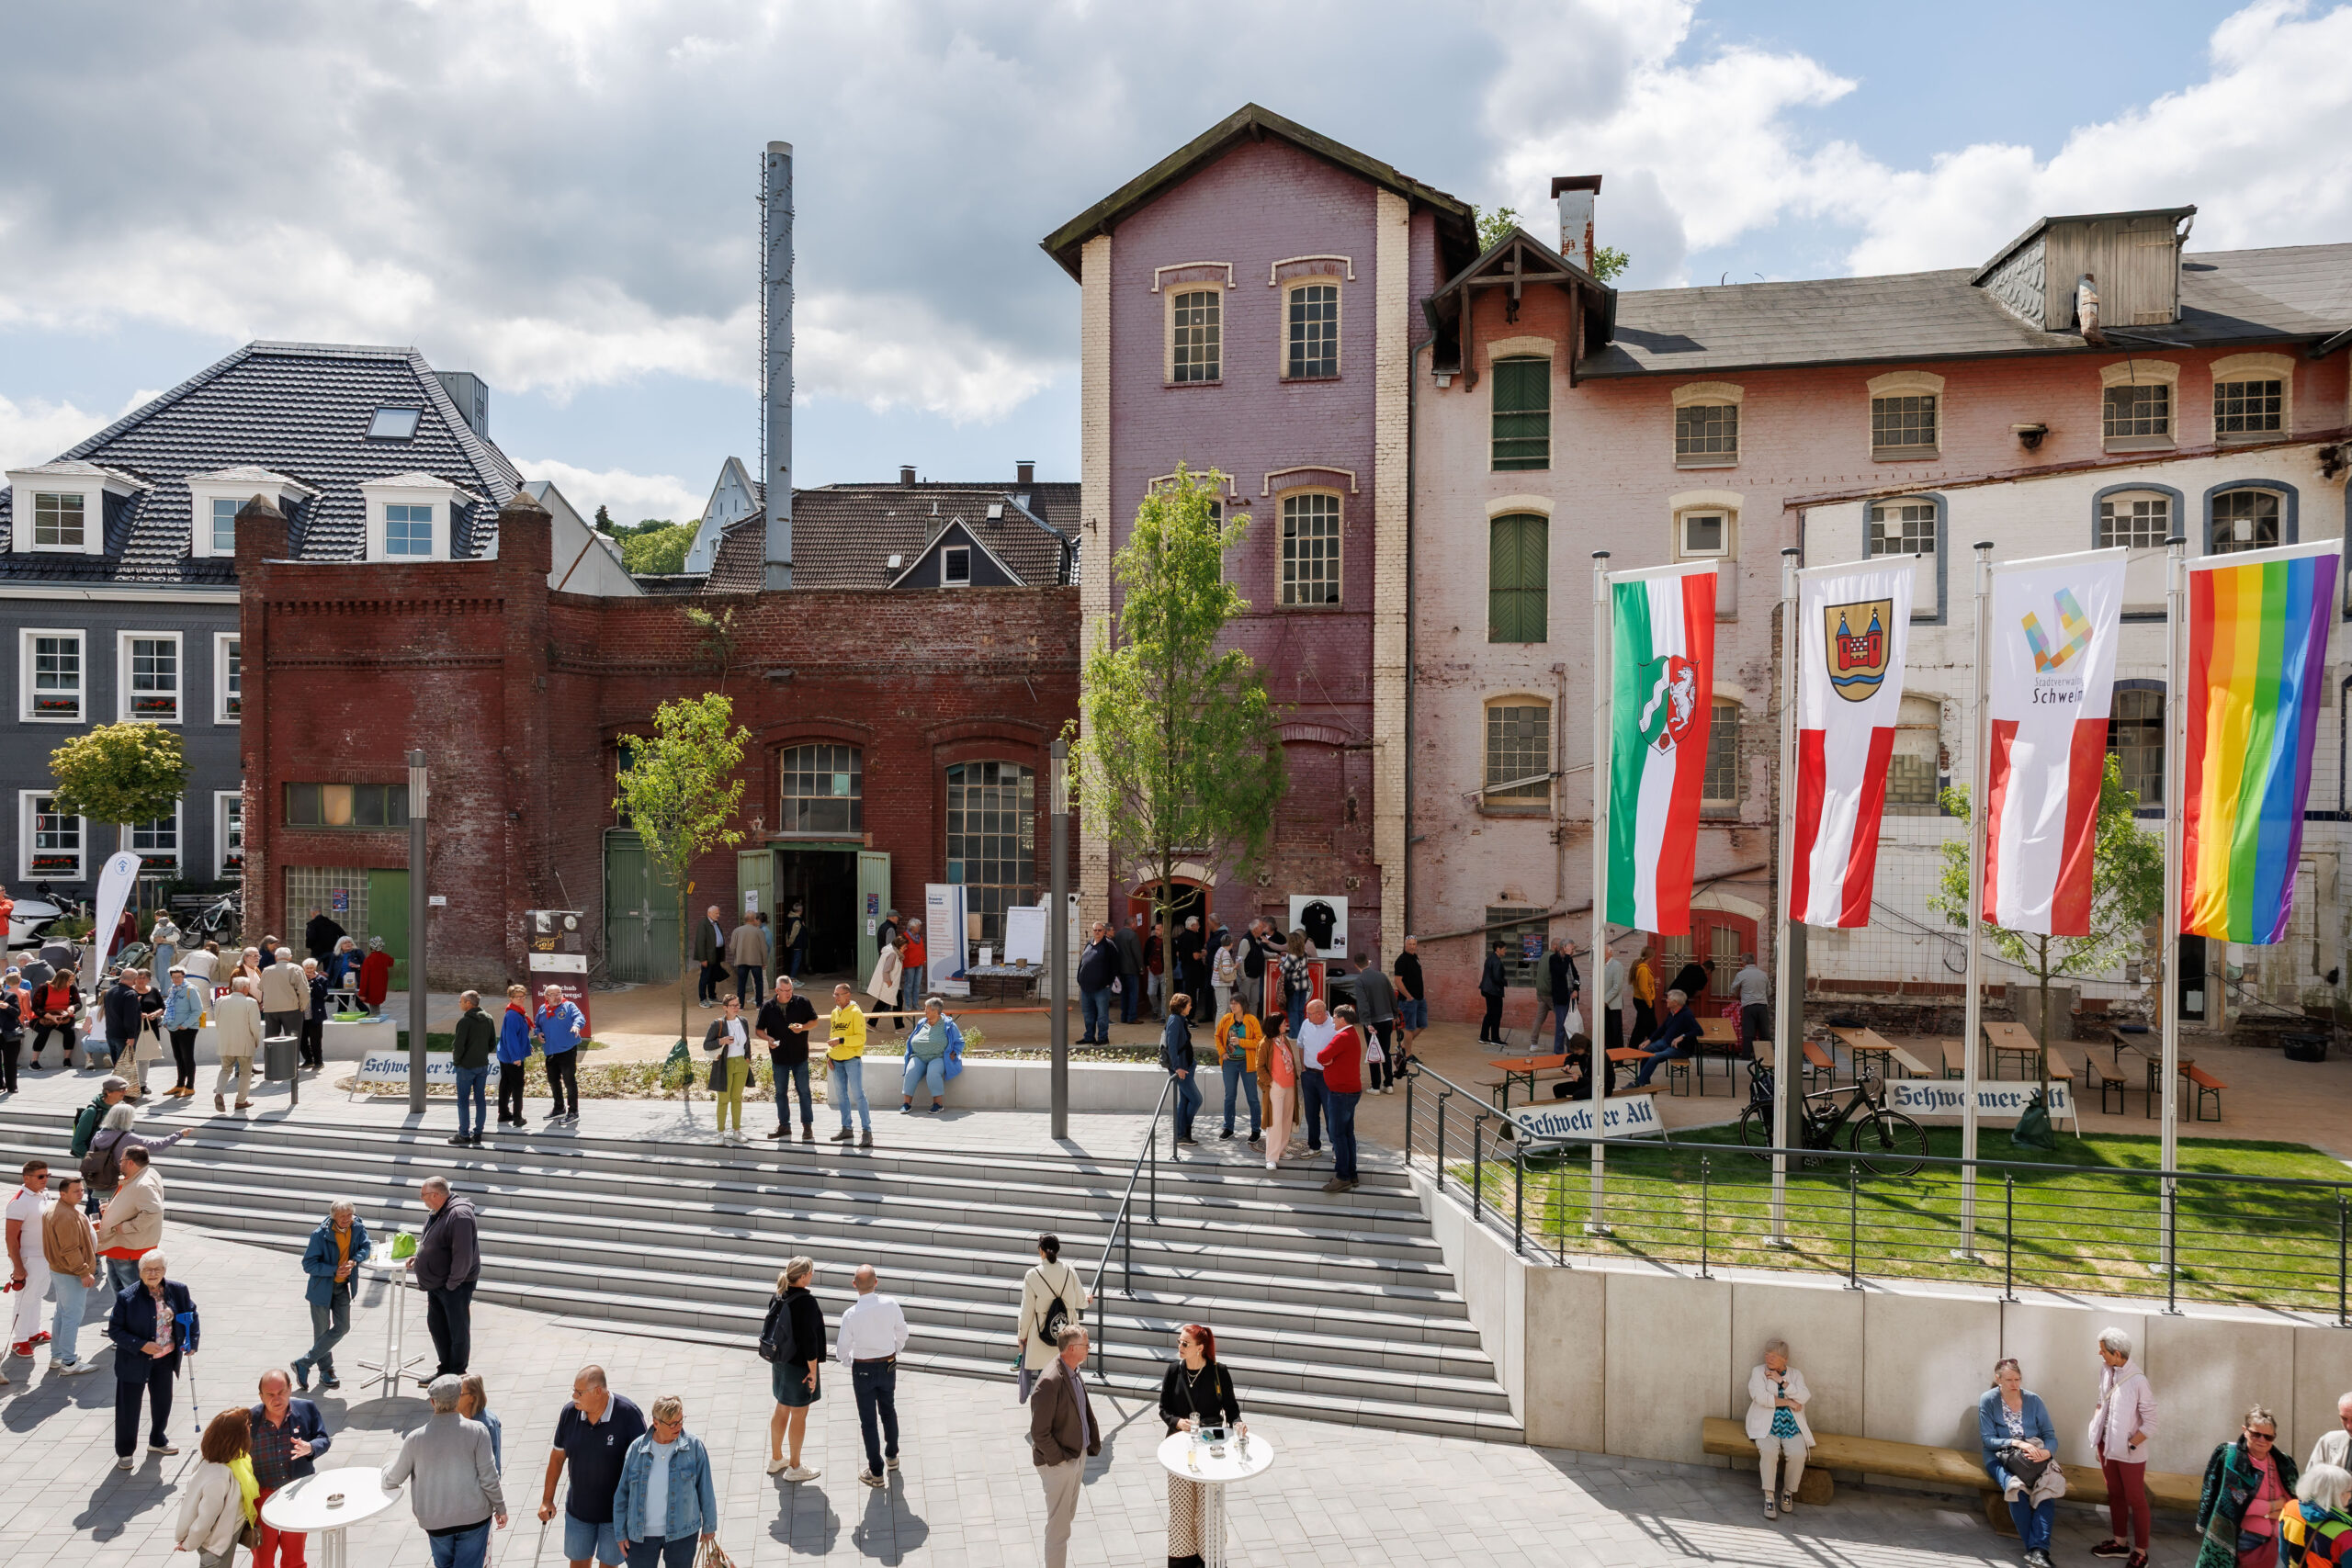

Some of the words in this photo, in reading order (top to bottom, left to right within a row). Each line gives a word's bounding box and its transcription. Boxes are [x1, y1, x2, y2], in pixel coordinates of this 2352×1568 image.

[363, 1057, 442, 1076] Schweer
[1893, 1085, 2021, 1112] Schwemer
[1624, 1100, 1654, 1124] Alt
